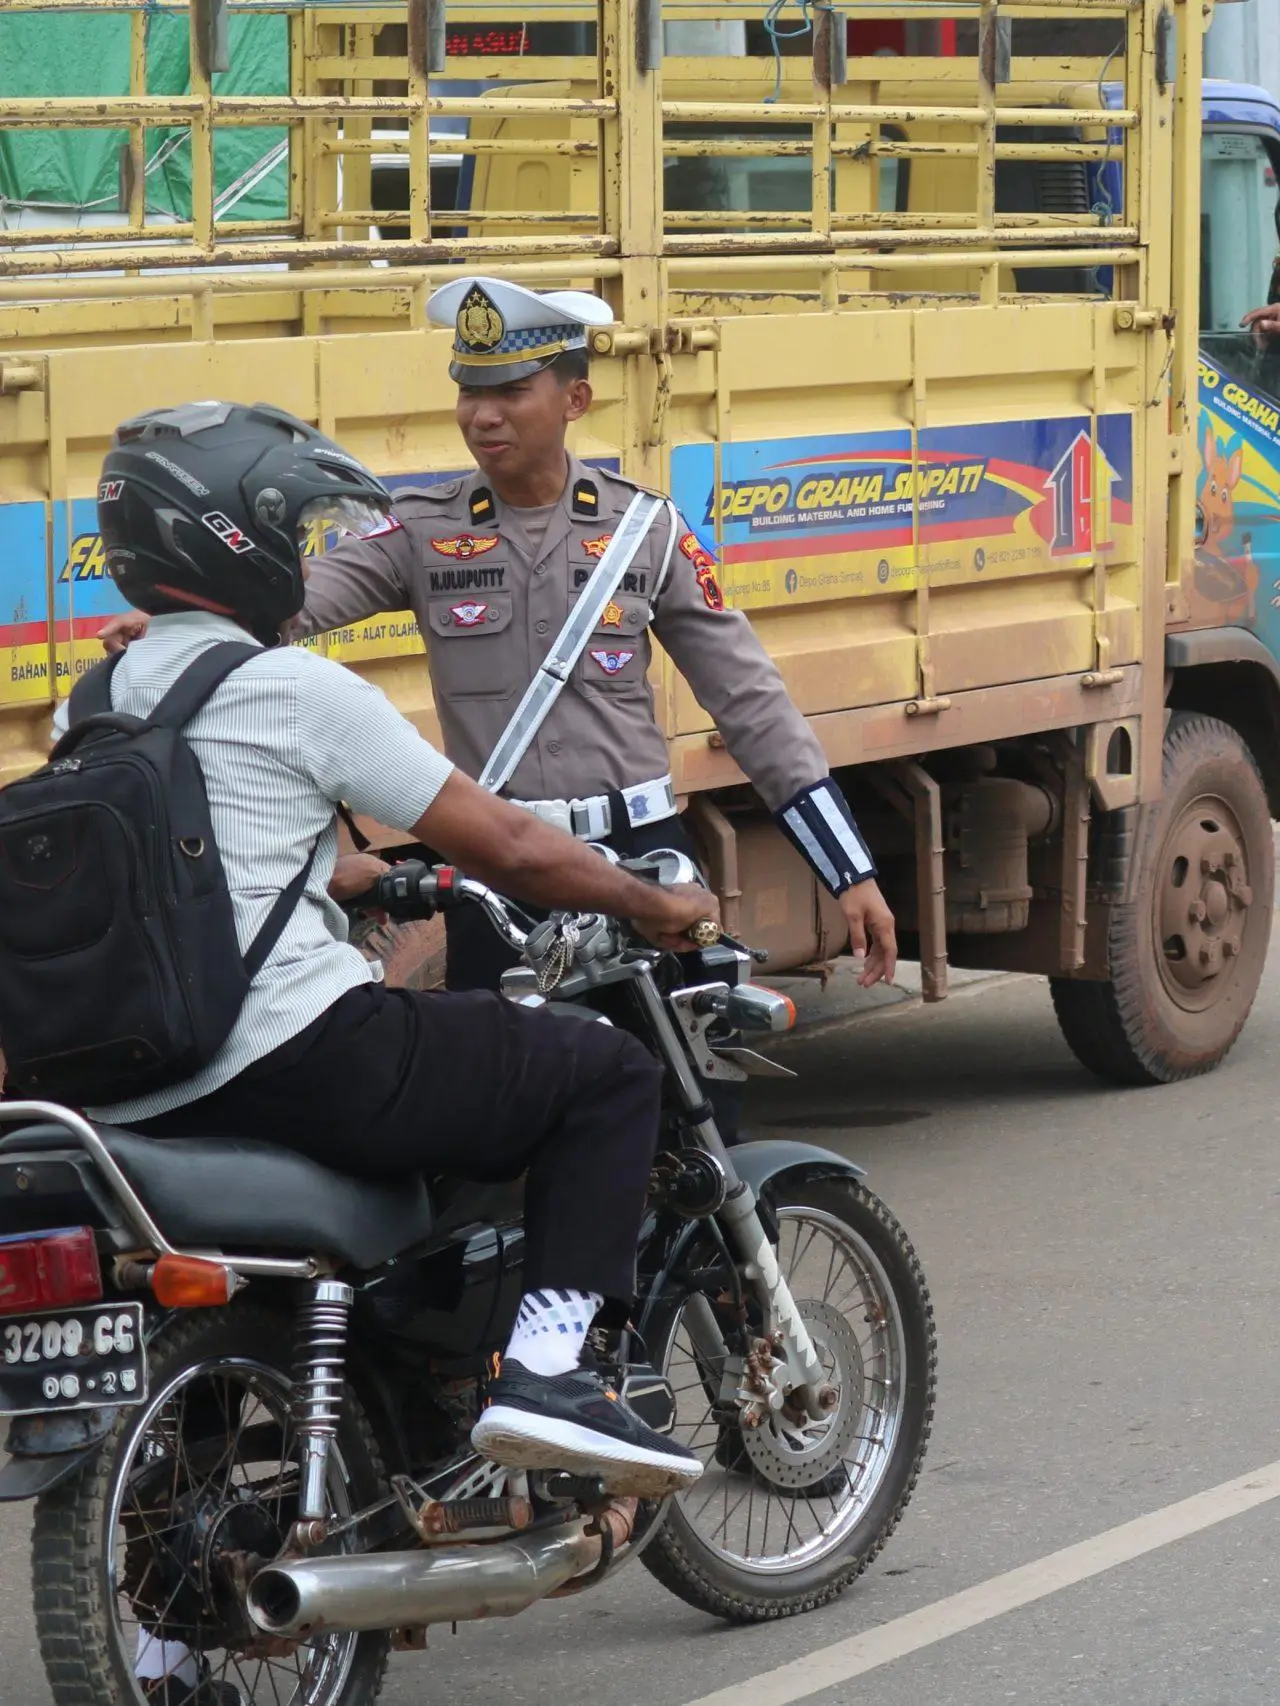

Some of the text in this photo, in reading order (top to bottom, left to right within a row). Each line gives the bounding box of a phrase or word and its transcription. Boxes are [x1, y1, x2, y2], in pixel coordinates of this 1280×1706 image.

[1223, 383, 1280, 430] GRAHA
[709, 483, 789, 518] DEPO
[795, 474, 884, 513] GRAHA
[752, 513, 796, 527] BUILDING
[797, 510, 844, 523] MATERIAL
[846, 507, 866, 517] AND
[868, 504, 895, 516] HOME
[202, 510, 256, 554] GM
[11, 661, 47, 682] BAHAN
[363, 624, 387, 641] ALAT
[4, 1318, 83, 1364] 3209
